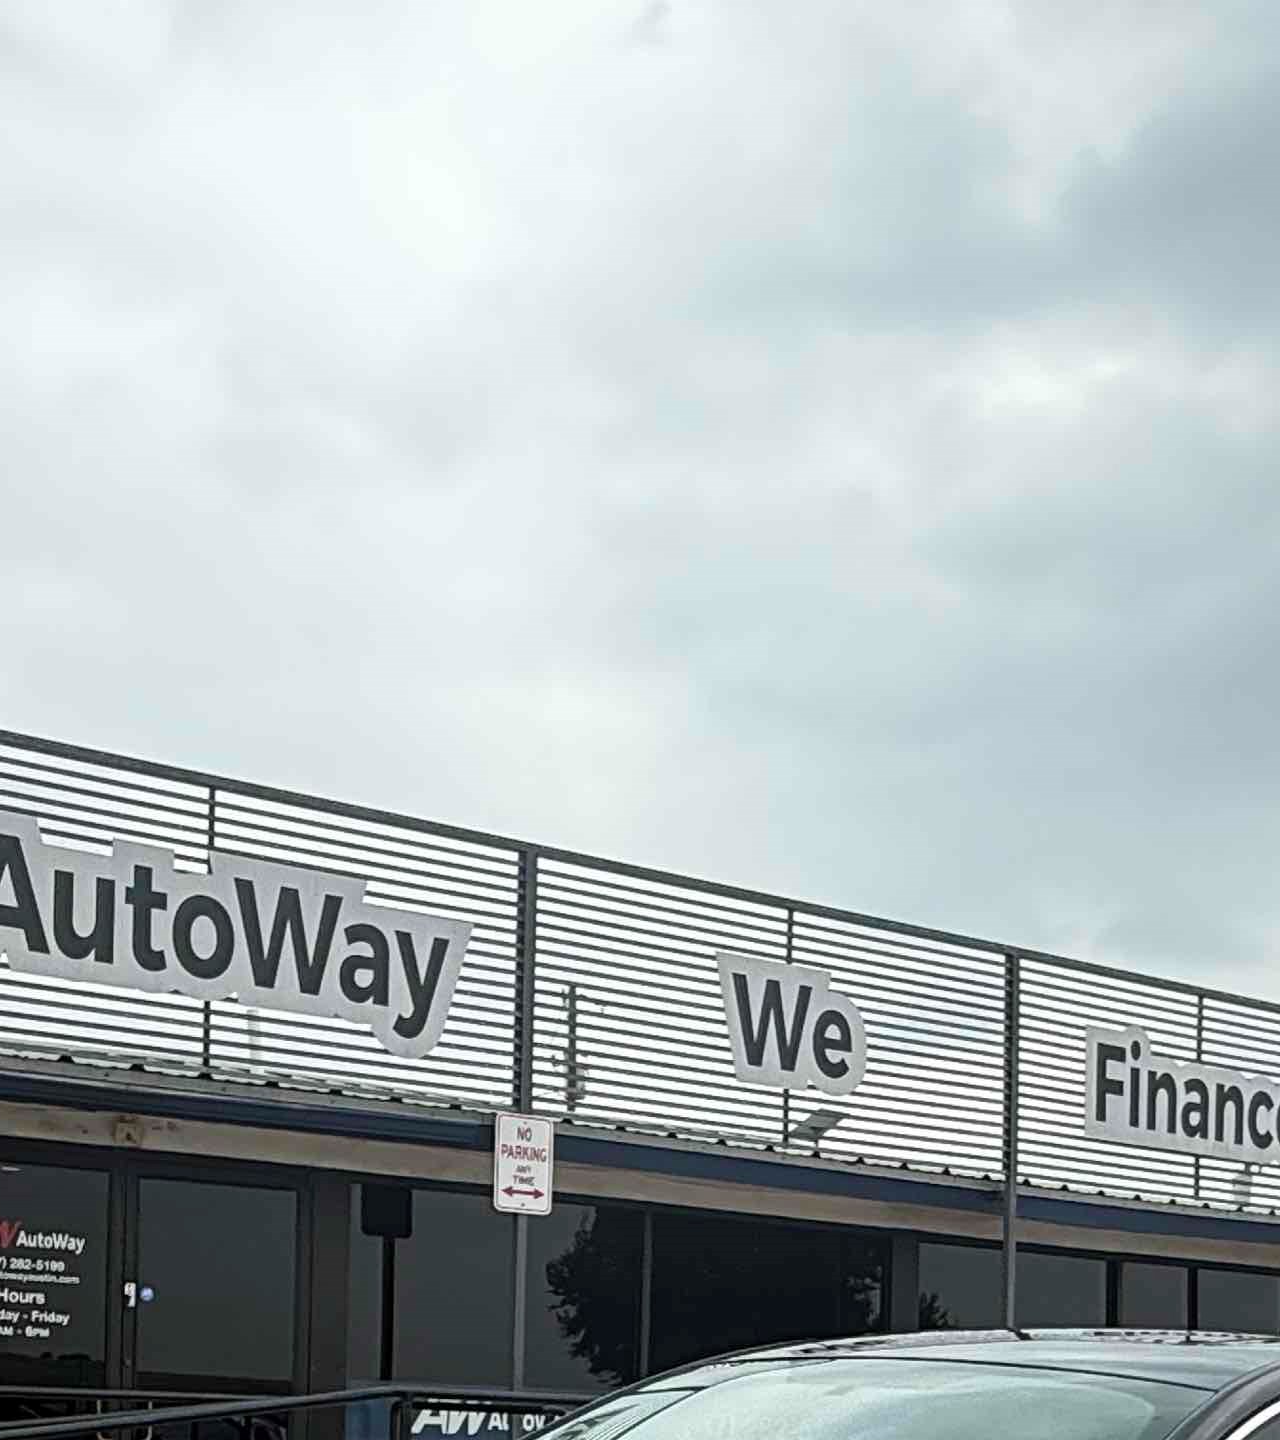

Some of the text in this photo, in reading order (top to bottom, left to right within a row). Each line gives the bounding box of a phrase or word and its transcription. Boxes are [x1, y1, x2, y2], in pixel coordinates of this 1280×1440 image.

[732, 972, 852, 1079] We
[517, 1127, 532, 1141] NO
[501, 1144, 547, 1162] PARKING
[16, 1230, 86, 1254] AutoWay
[9, 1257, 66, 1272] 282-5199
[31, 1310, 70, 1326] Friday
